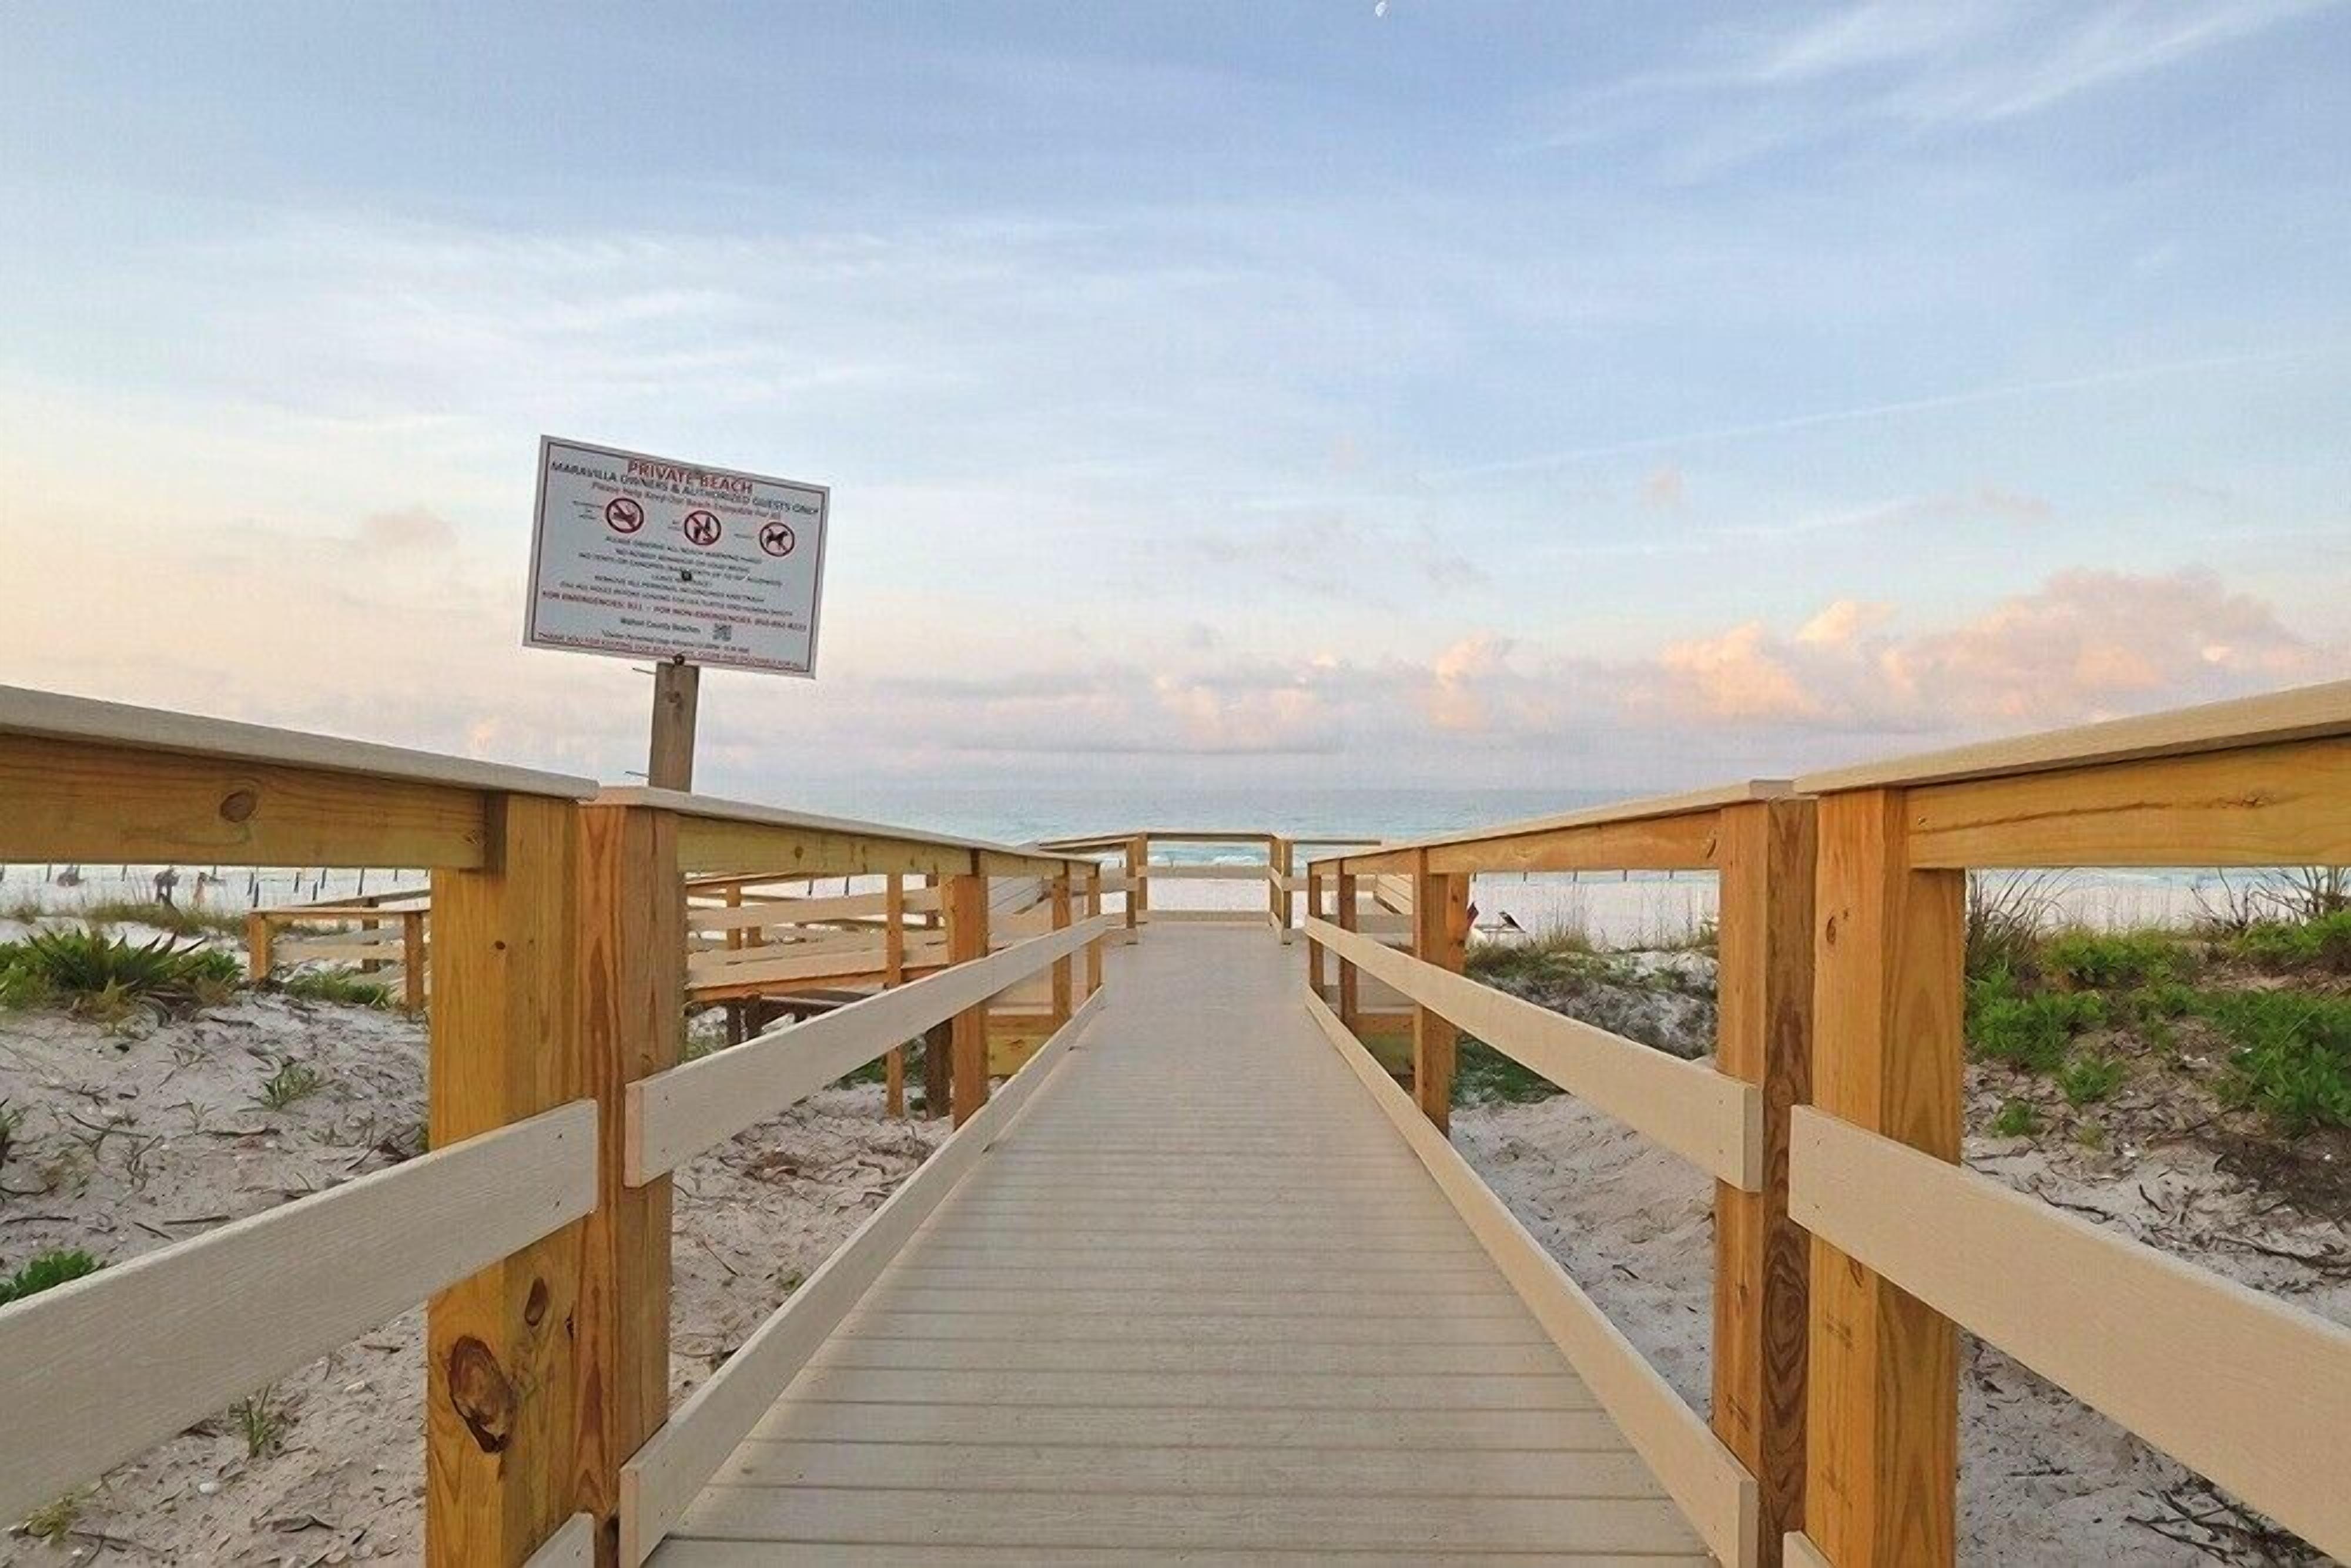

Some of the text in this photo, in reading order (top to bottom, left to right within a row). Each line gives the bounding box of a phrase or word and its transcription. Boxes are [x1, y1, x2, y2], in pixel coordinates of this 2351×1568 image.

[550, 461, 617, 482] MARAVILLA
[628, 460, 752, 495] PRIVATE BEACH
